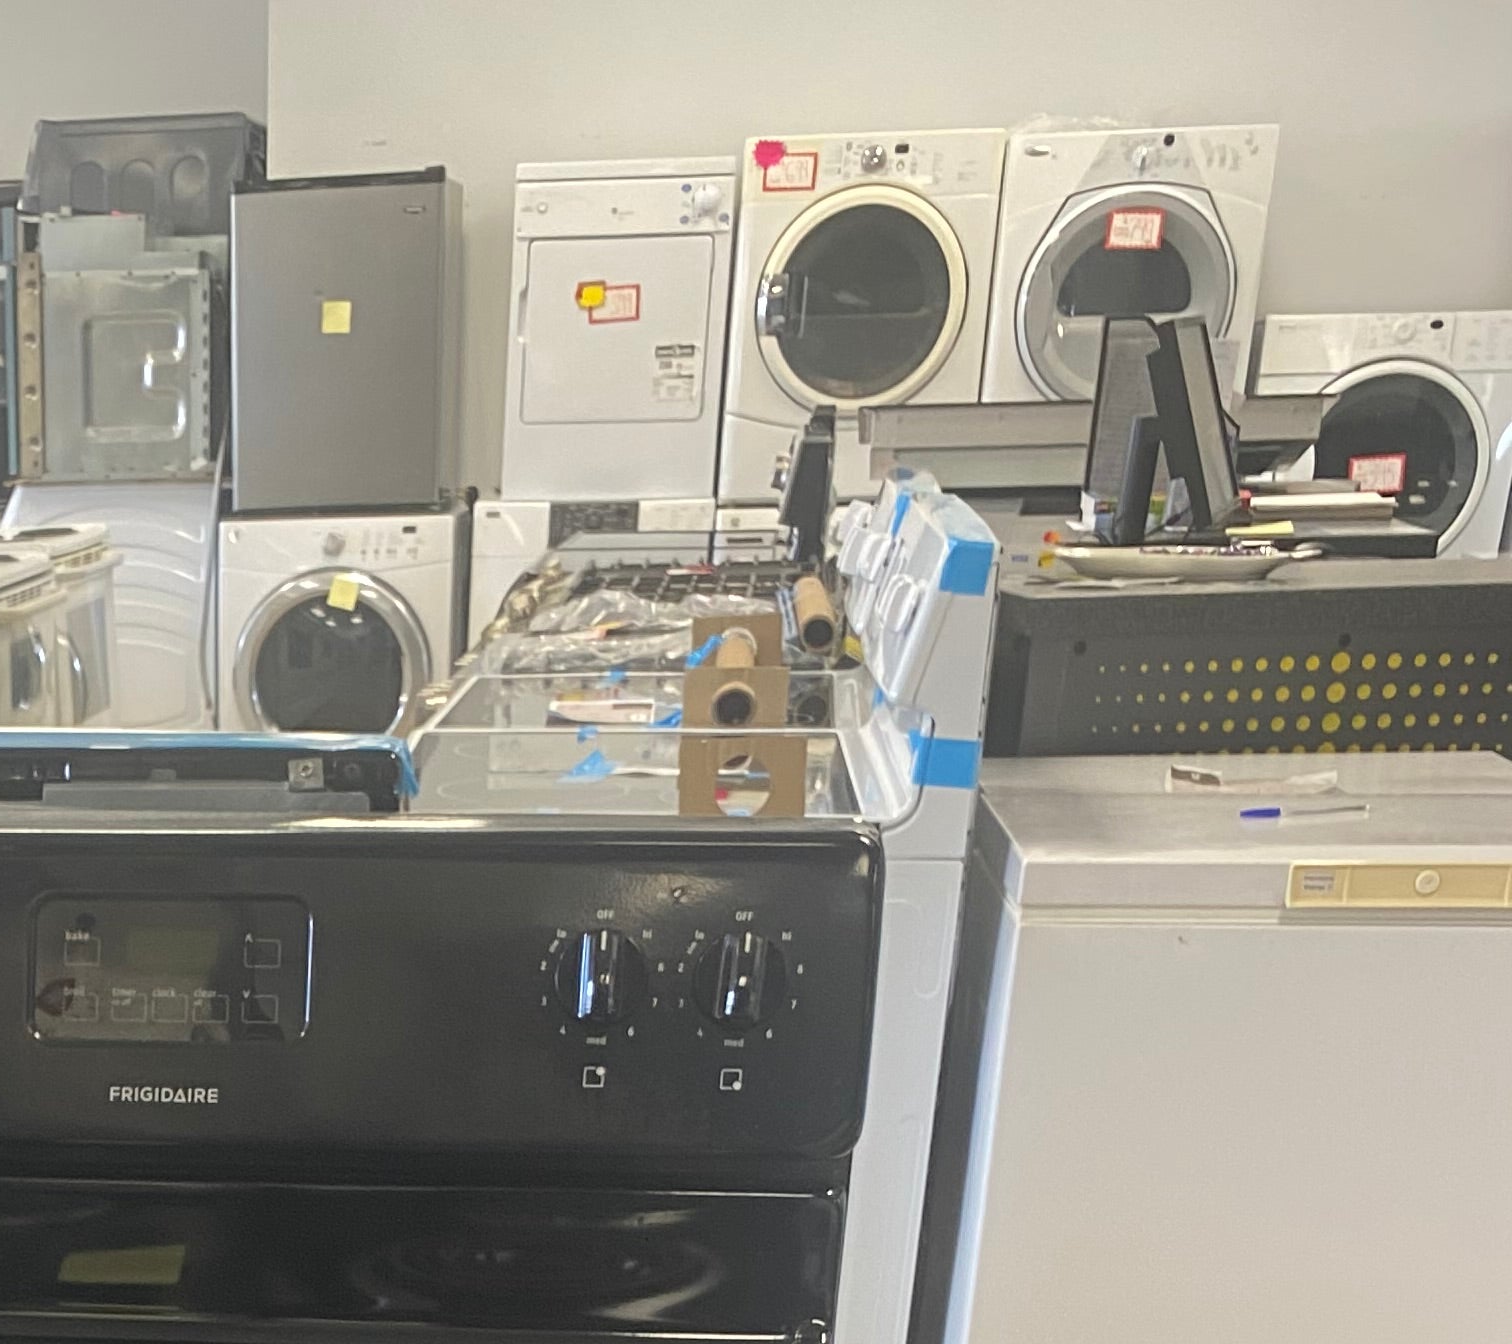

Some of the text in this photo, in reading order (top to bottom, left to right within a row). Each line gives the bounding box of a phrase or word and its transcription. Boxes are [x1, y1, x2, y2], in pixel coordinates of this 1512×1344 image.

[596, 909, 615, 920] OFF
[735, 911, 754, 922] OFF
[109, 1086, 219, 1104] FRIGIDAIRE
